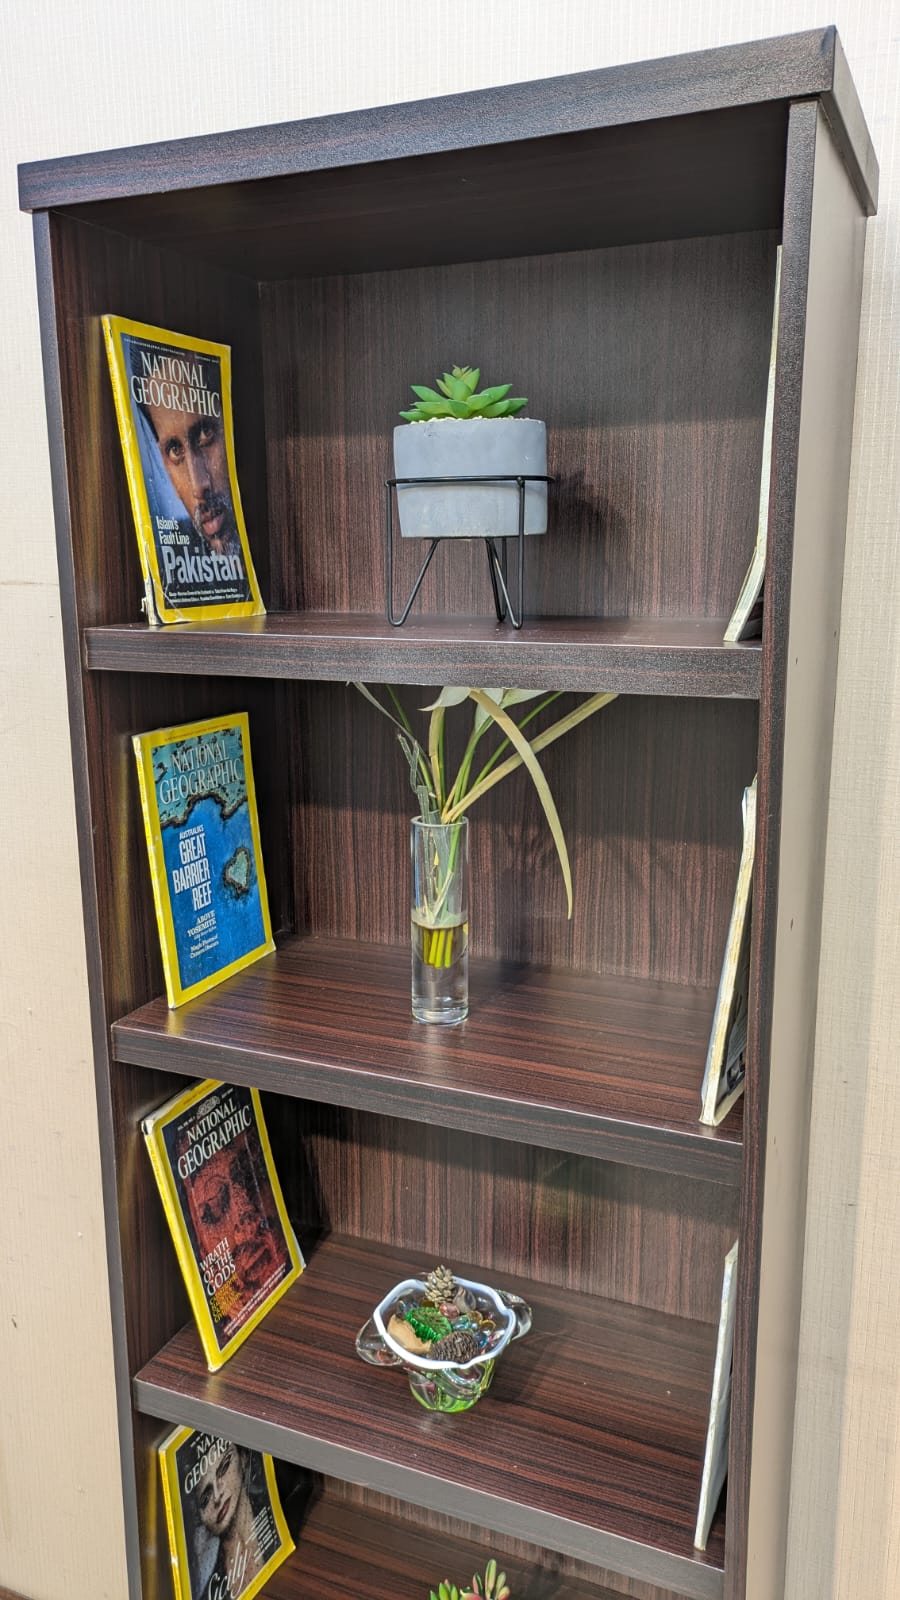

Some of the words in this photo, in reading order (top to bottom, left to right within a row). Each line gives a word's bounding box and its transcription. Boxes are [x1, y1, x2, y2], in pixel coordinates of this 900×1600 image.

[140, 351, 208, 389] NATIONAL
[130, 375, 221, 418] GEOGRAPHIC
[155, 515, 179, 531] Islam's
[158, 531, 176, 545] Fault
[174, 531, 190, 545] Line
[161, 545, 244, 584] Pakistan
[172, 740, 229, 775] NATIONAL
[159, 758, 243, 805] GEOGRAPHIC
[179, 833, 207, 865] GREAT
[172, 857, 211, 894] BARRIER
[192, 880, 212, 911] REEF
[187, 1098, 237, 1146] NATIONAL
[177, 1105, 252, 1180] GEOGRAPHIC
[200, 1237, 229, 1271] WRATH
[203, 1265, 214, 1283] OF
[214, 1248, 233, 1271] THE
[207, 1259, 236, 1296] GODS
